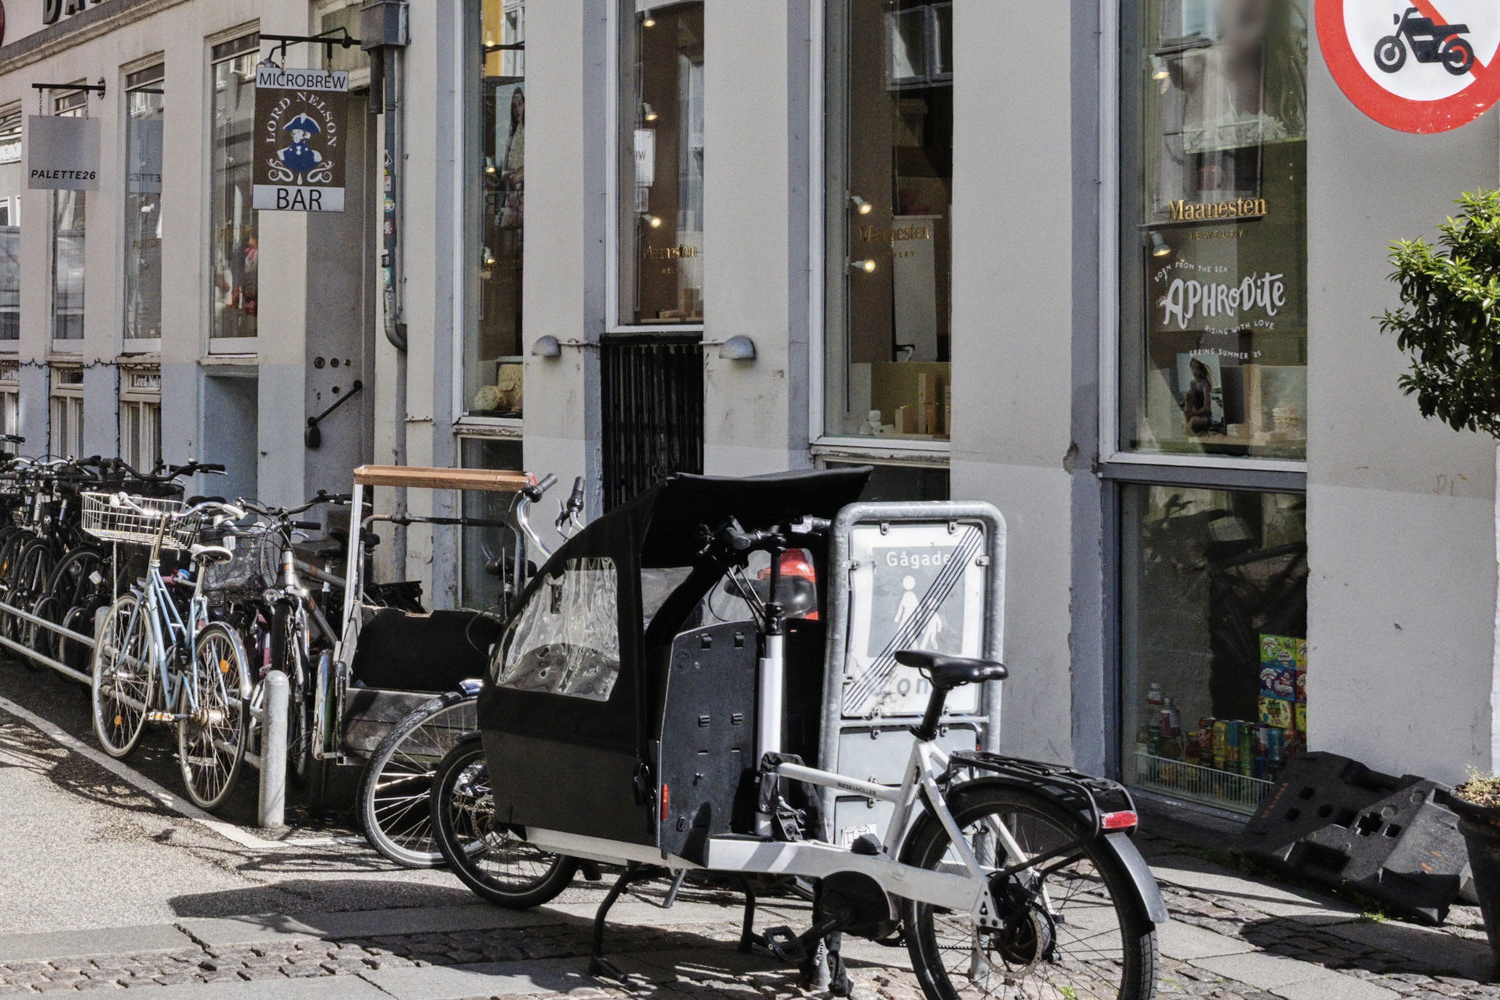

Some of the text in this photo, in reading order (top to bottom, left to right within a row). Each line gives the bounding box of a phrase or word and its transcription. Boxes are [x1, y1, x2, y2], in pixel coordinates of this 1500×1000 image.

[259, 73, 346, 89] MICROBREW
[266, 92, 337, 147] LORD NELSON
[31, 169, 96, 180] PALETTE26
[276, 188, 322, 211] BAR
[1168, 195, 1268, 222] Maanesten
[1154, 264, 1172, 283] BORN
[1175, 261, 1195, 270] FROM
[1198, 265, 1212, 273] THE
[1205, 319, 1275, 335] RISING WITH LOVE
[1189, 348, 1215, 357] SPRING
[1218, 349, 1248, 360] SUMMER
[886, 551, 951, 569] Gågade
